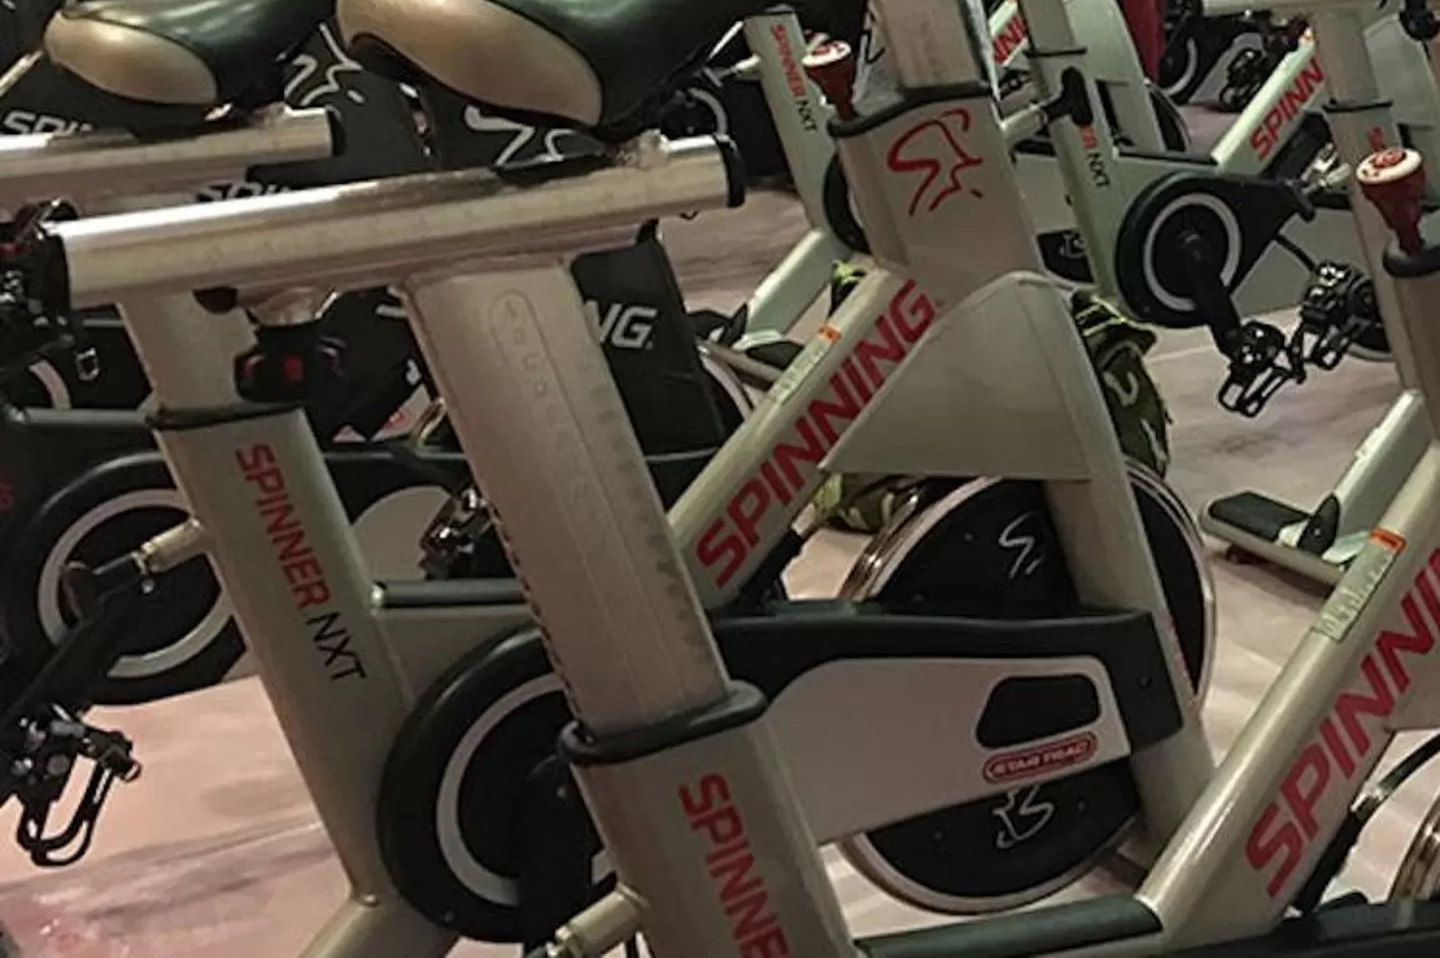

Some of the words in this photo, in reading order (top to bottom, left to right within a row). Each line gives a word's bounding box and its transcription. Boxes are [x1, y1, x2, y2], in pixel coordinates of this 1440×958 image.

[234, 443, 332, 610] SPINNER
[305, 611, 366, 682] NXT
[695, 278, 936, 588] SPINNING
